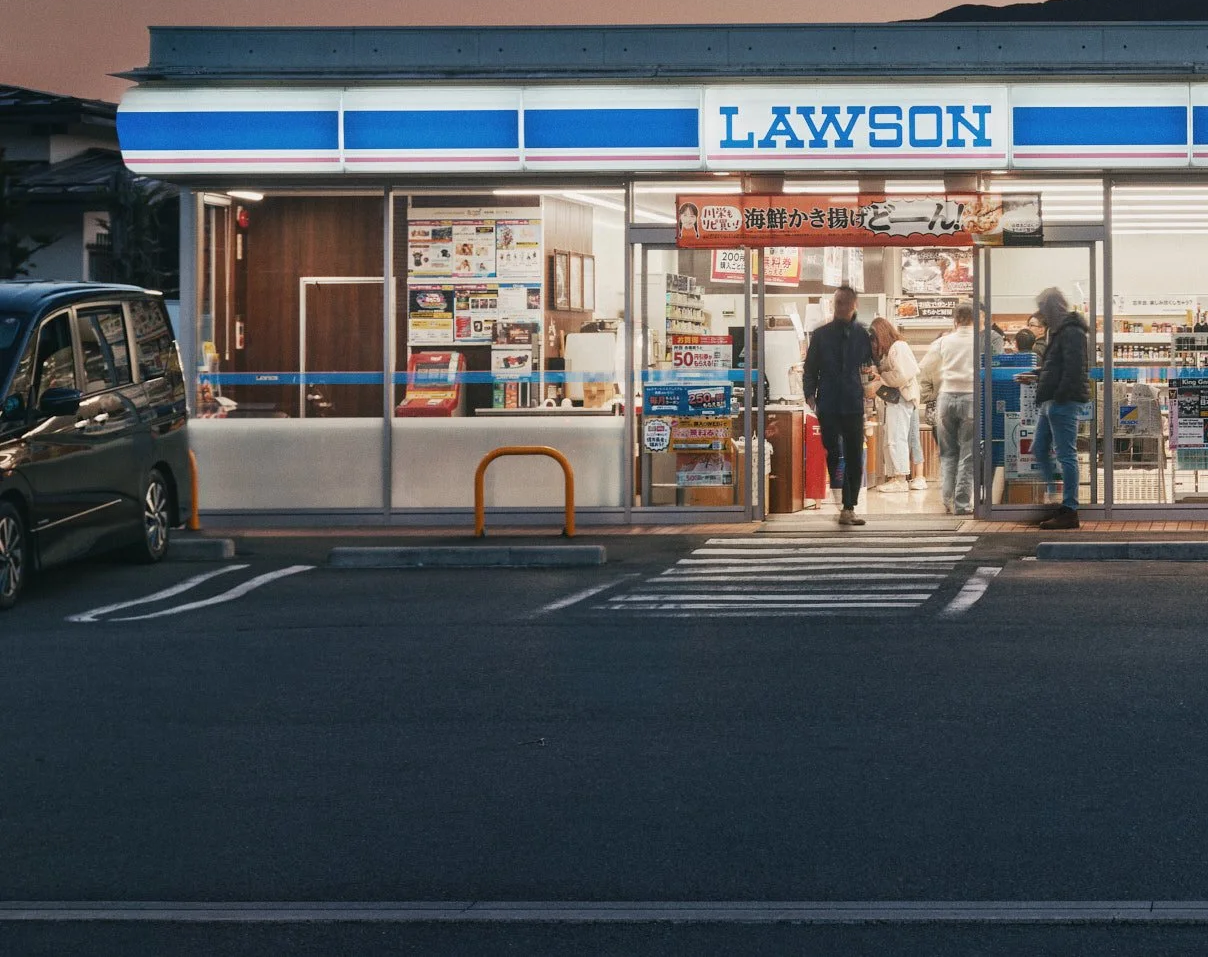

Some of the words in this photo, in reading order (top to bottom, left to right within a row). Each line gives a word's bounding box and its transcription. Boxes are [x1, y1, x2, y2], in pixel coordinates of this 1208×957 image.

[719, 105, 992, 149] LAWSON
[744, 207, 871, 230] 海鮮かき揚げ
[673, 351, 694, 367] 50
